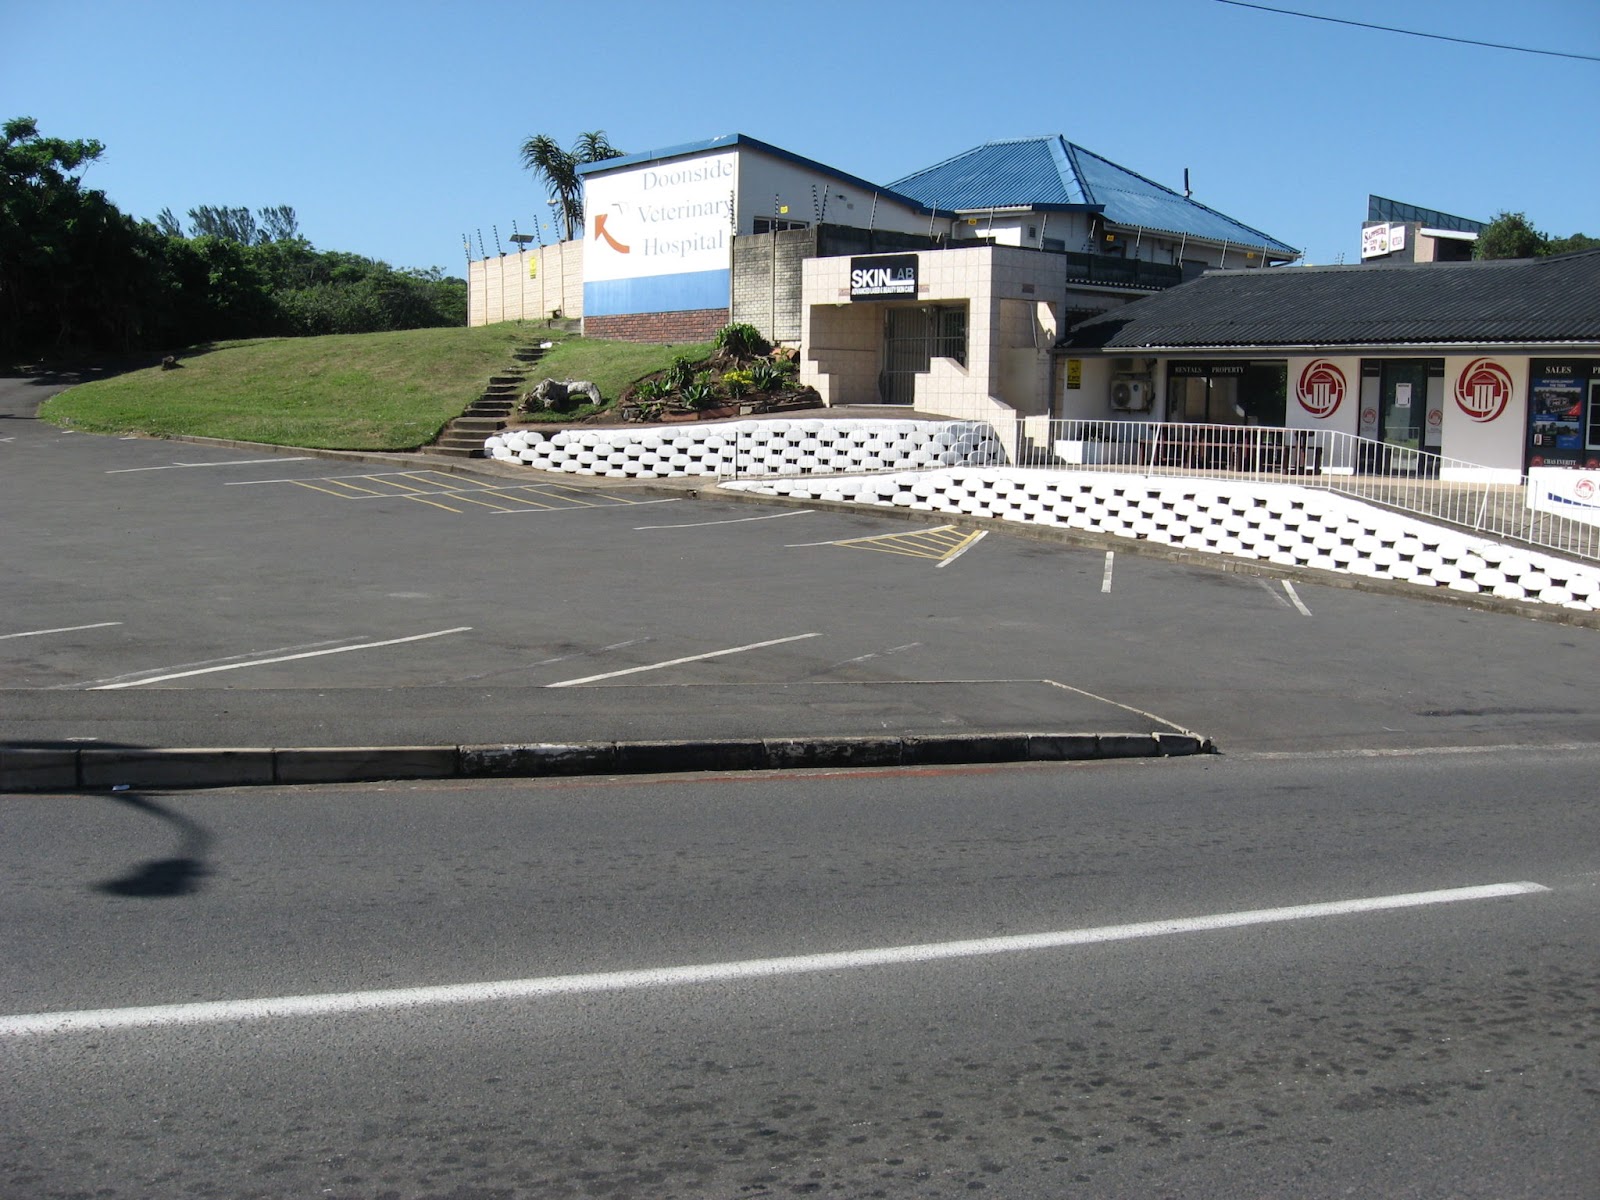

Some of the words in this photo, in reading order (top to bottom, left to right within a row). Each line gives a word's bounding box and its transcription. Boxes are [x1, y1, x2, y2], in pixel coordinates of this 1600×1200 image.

[643, 160, 733, 190] Doonside
[638, 200, 732, 223] Veterinary
[644, 230, 724, 257] Hospital
[1545, 366, 1572, 374] SALES
